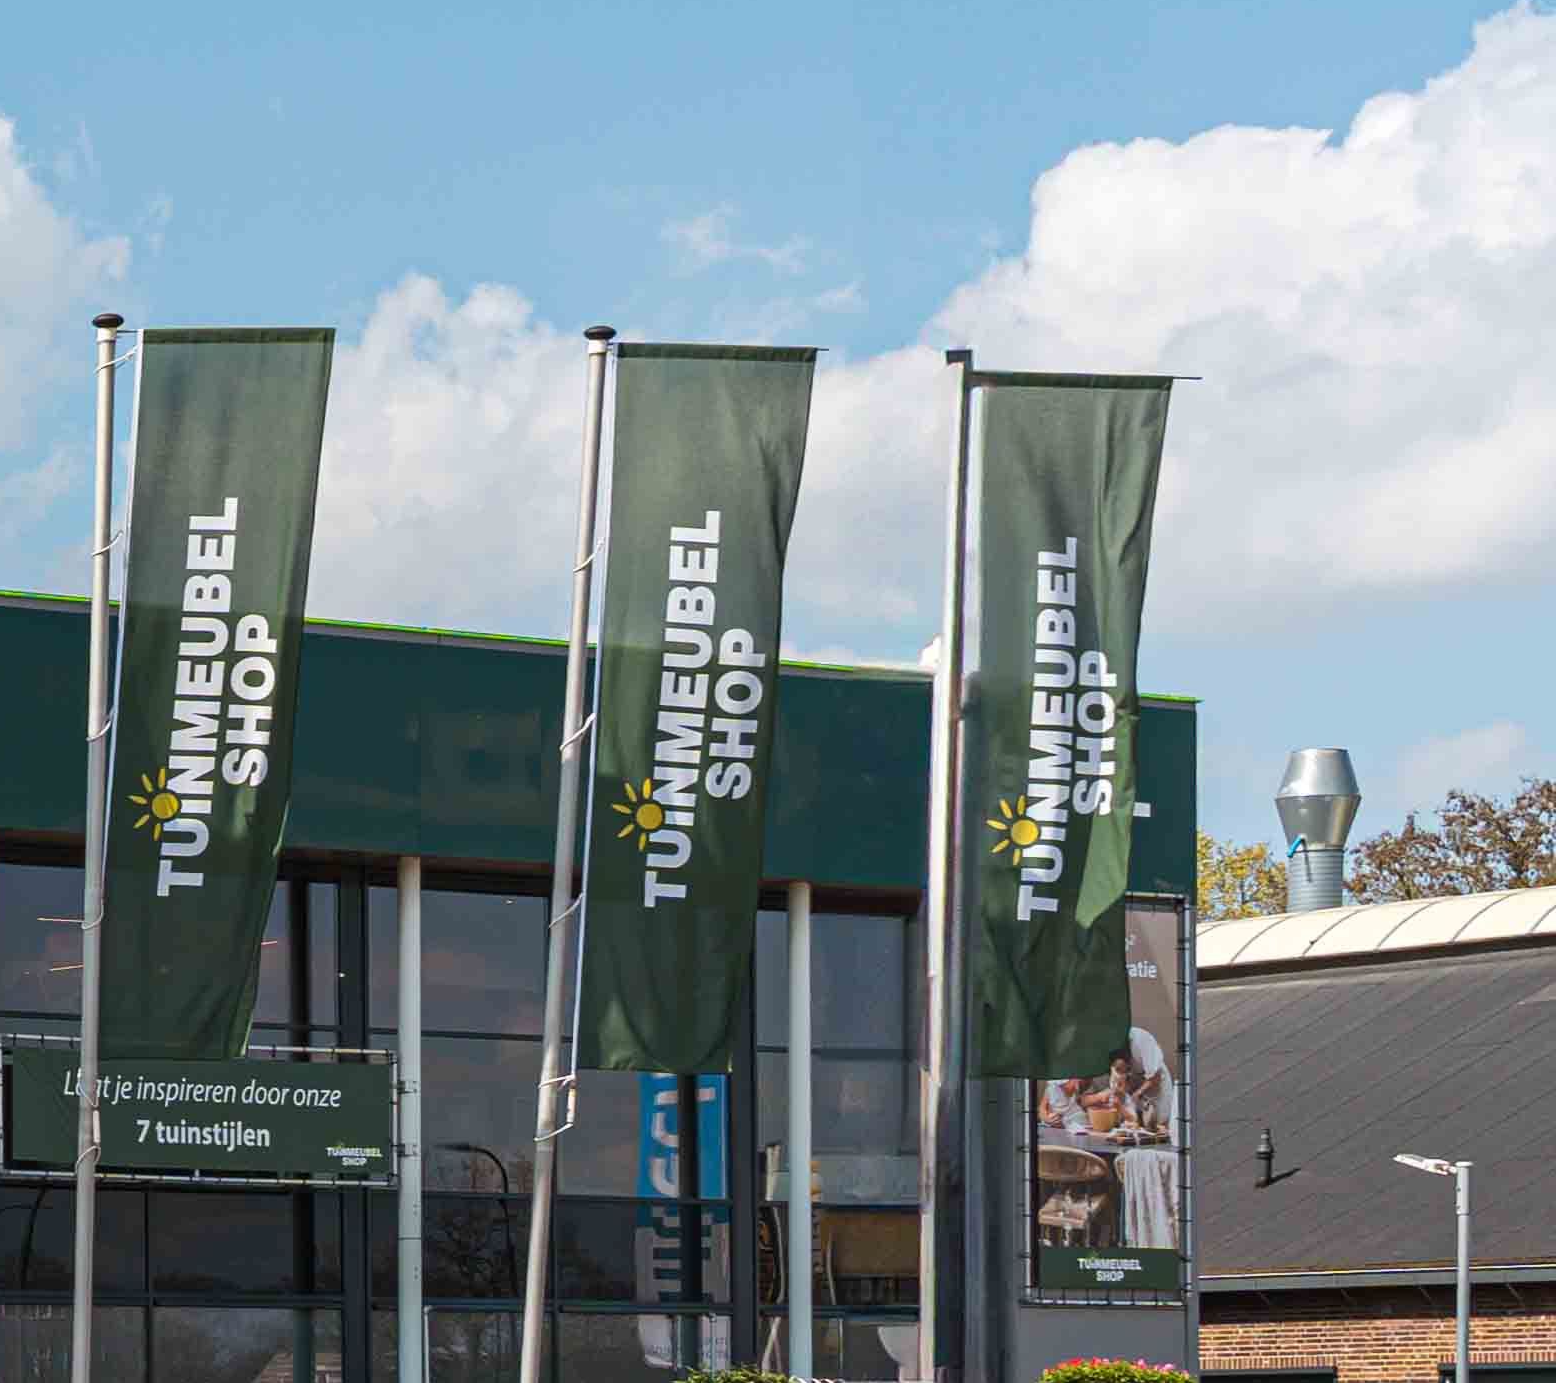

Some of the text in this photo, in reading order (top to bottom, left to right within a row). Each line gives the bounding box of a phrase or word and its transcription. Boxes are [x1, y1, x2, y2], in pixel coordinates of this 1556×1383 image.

[222, 614, 277, 787] SHOP
[706, 628, 765, 800] SHOP
[1073, 650, 1117, 816] SHOP
[111, 1074, 132, 1105] je
[136, 1076, 236, 1106] inspireren
[242, 1079, 290, 1106] door
[293, 1086, 342, 1108] onze
[137, 1119, 270, 1152] 7 tuinstijlen
[1096, 1270, 1124, 1281] SHOP
